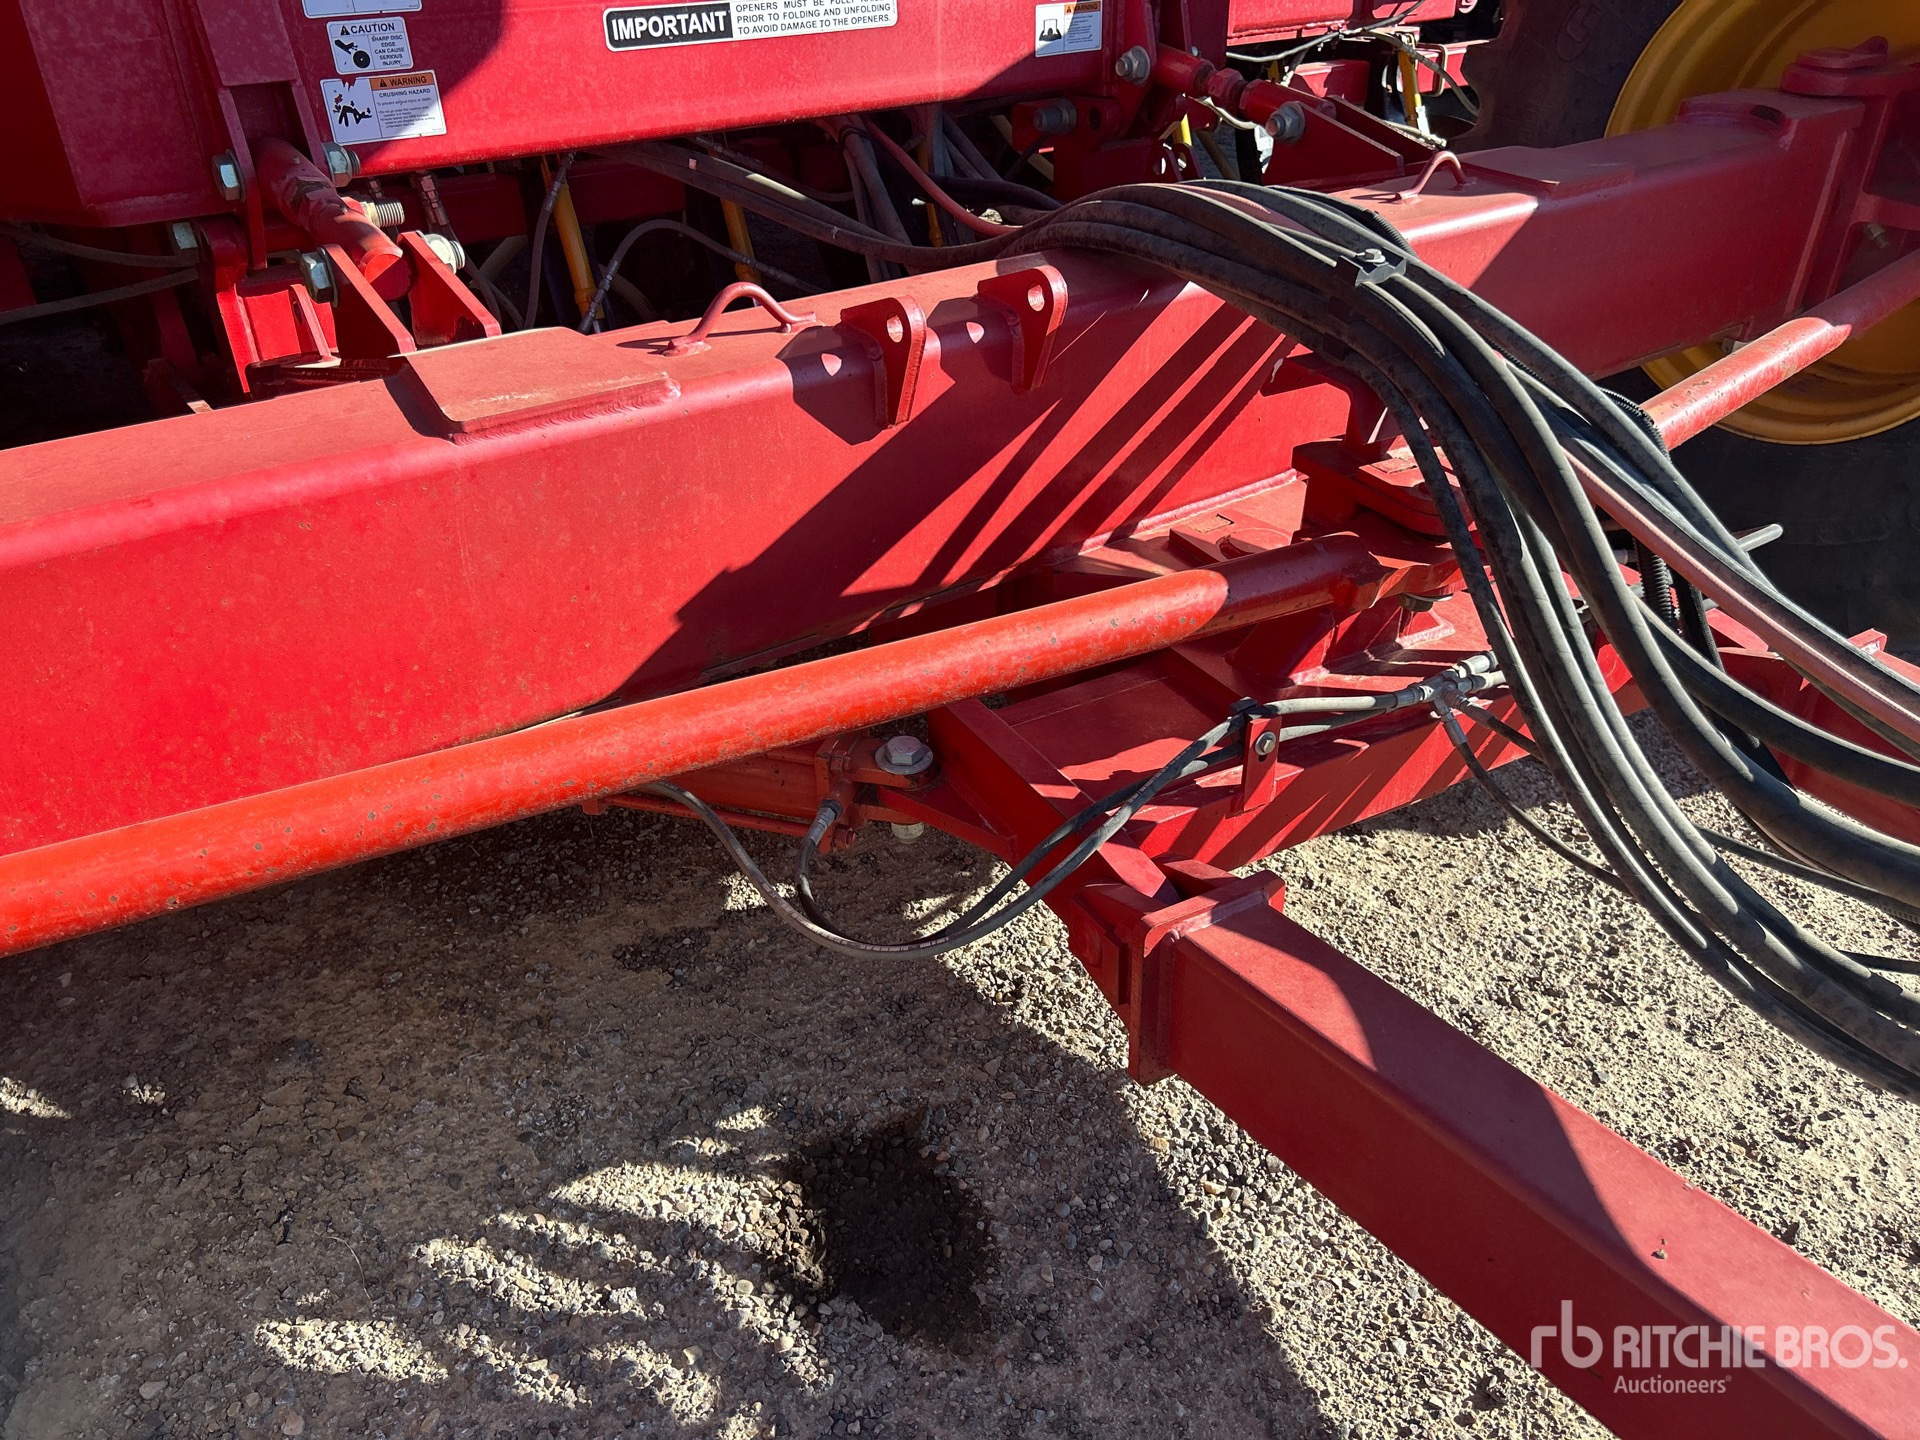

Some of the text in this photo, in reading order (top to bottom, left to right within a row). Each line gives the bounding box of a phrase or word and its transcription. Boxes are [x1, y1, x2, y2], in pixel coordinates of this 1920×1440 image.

[735, 2, 778, 13] OPENERS
[783, 0, 808, 8] MUST
[736, 3, 891, 24] PRIOR TO FOLDING AND UNFOLDING
[350, 22, 395, 34] CAUTION
[611, 10, 727, 41] IMPORTANT
[738, 26, 750, 35] TO
[752, 24, 779, 34] AVOID
[780, 20, 818, 31] DAMAGE
[820, 19, 831, 28] TO
[833, 17, 849, 26] THE
[389, 75, 427, 87] WARNING
